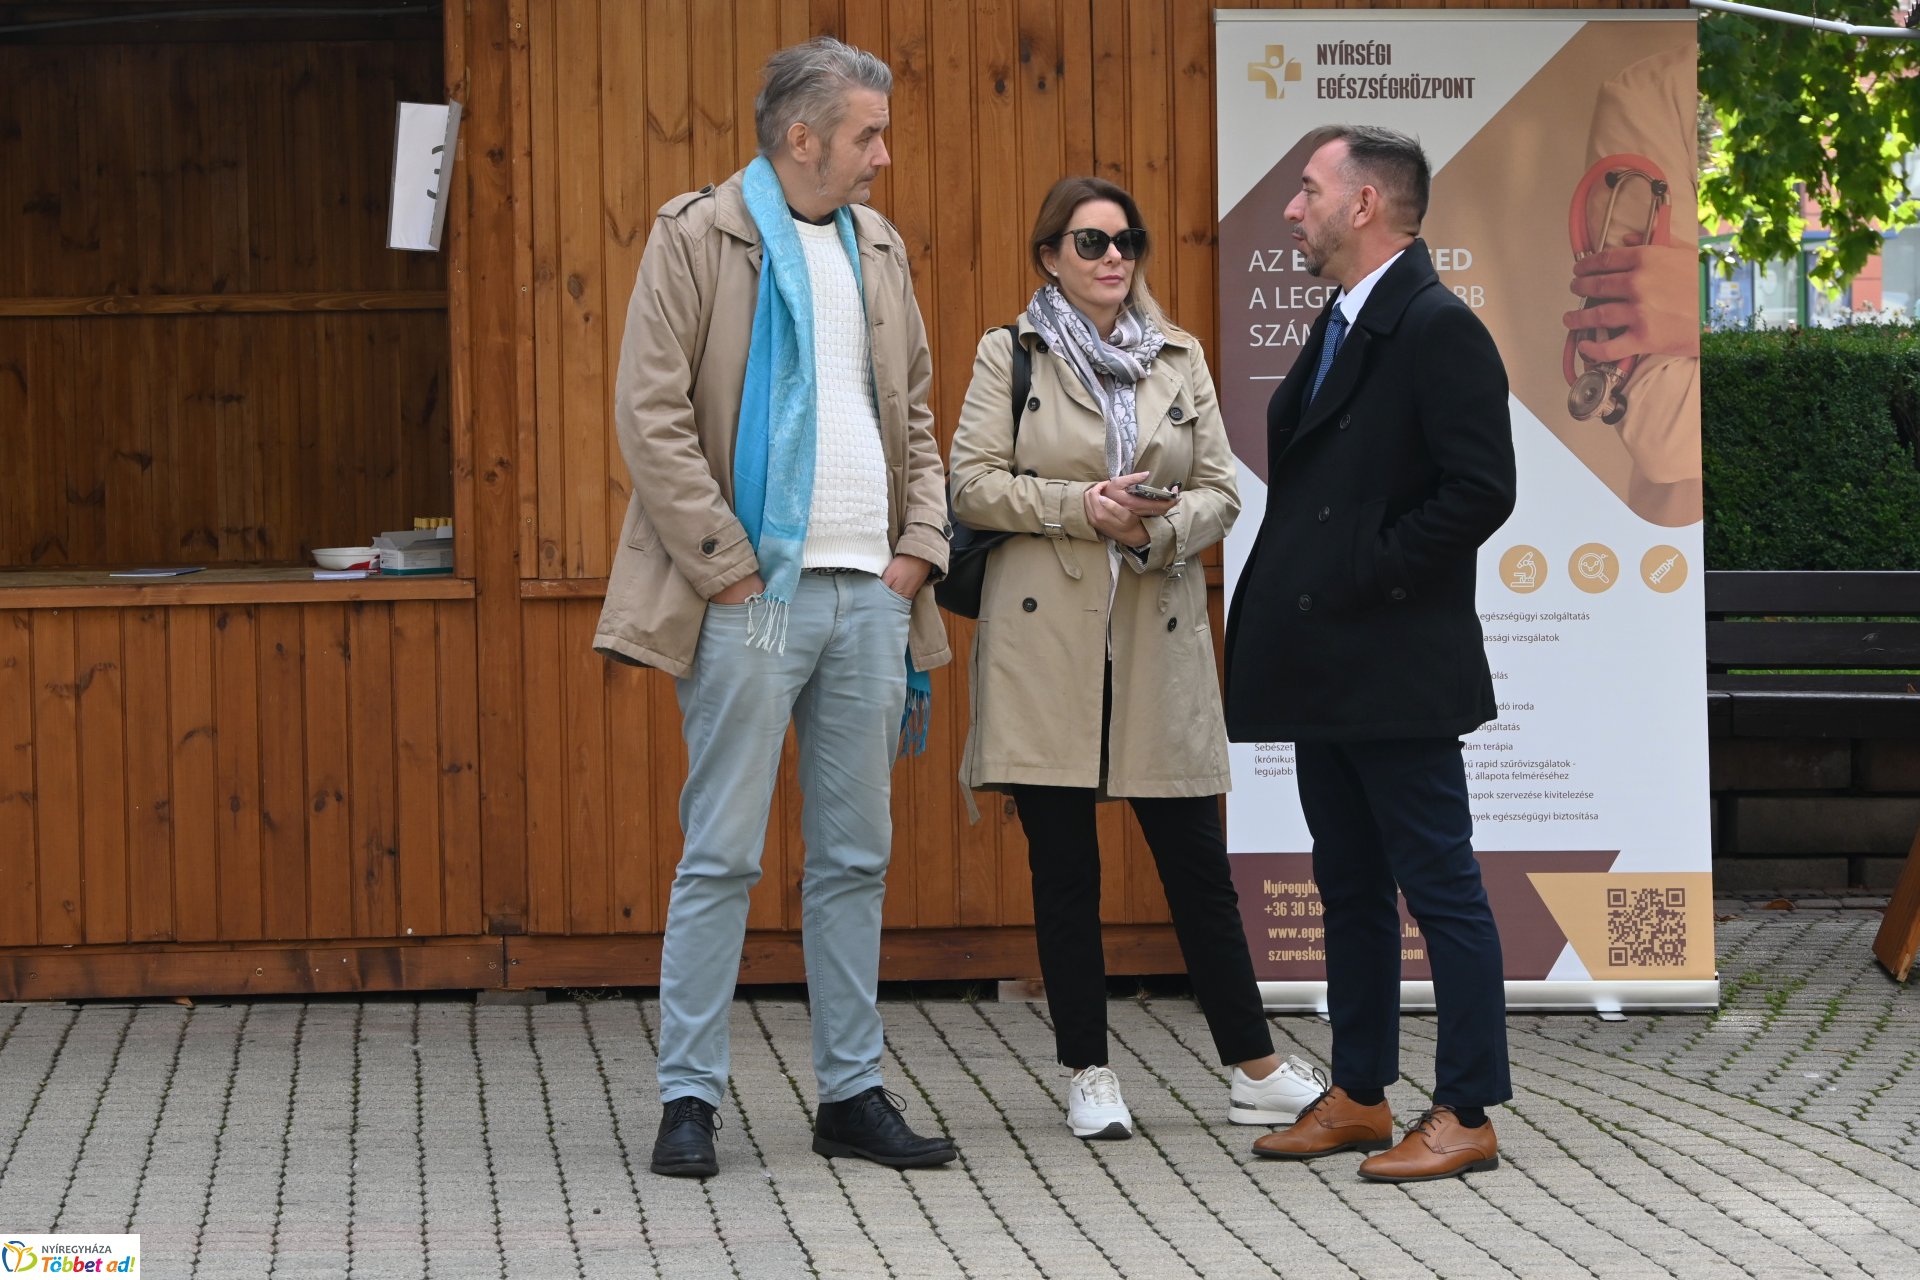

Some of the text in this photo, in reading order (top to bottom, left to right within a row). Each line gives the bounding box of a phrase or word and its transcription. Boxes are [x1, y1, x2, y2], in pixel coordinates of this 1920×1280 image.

[1317, 40, 1392, 65] NYÍRSÉGI
[1317, 74, 1475, 99] EGÉSZSÉGKÖZPONT
[1248, 250, 1284, 272] AZ
[1249, 287, 1267, 309] A
[1480, 611, 1590, 623] egészségügyi szolgáltatás
[1512, 633, 1560, 644] vizsgálatok
[1512, 701, 1535, 711] iroda
[1476, 722, 1521, 733] olgáltatás
[1254, 743, 1294, 752] Sebészet
[1483, 742, 1513, 753] terápia
[1254, 755, 1295, 765] (krónikus
[1475, 759, 1498, 770] rapid
[1500, 759, 1571, 770] szűrővizsgálatok
[1254, 767, 1294, 778] legújabb
[1475, 771, 1510, 782] állapota
[1512, 771, 1569, 781] felméréséhez
[1496, 790, 1542, 800] szervezése
[1544, 790, 1594, 800] kivitelezése
[1493, 811, 1551, 823] egészségügyi
[1553, 811, 1599, 821] biztosítása
[1264, 901, 1288, 917] +36
[1290, 901, 1306, 917] 30
